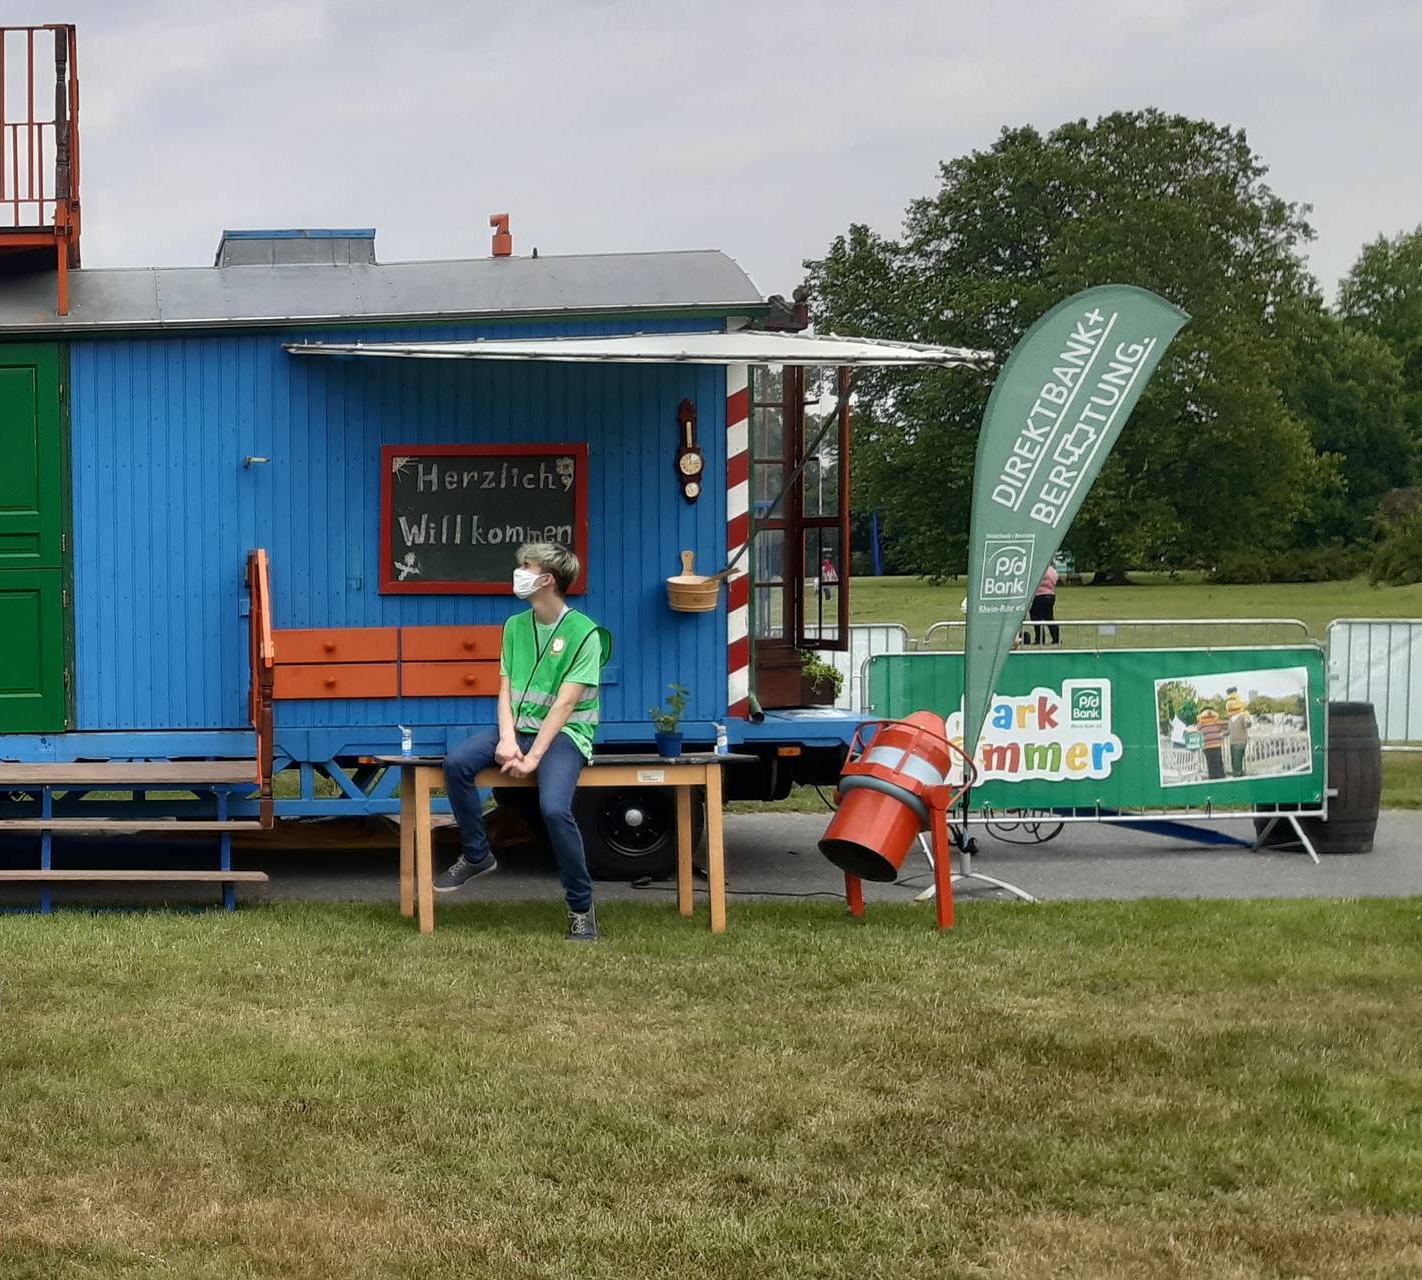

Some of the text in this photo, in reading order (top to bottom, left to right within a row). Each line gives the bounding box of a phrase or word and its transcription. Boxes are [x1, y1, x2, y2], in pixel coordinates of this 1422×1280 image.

[416, 462, 557, 492] Herzlich
[398, 512, 572, 547] Willkommen
[984, 577, 1025, 595] Bank
[992, 696, 1059, 731] ark
[1073, 708, 1101, 719] Bank
[981, 741, 1116, 774] mmer
